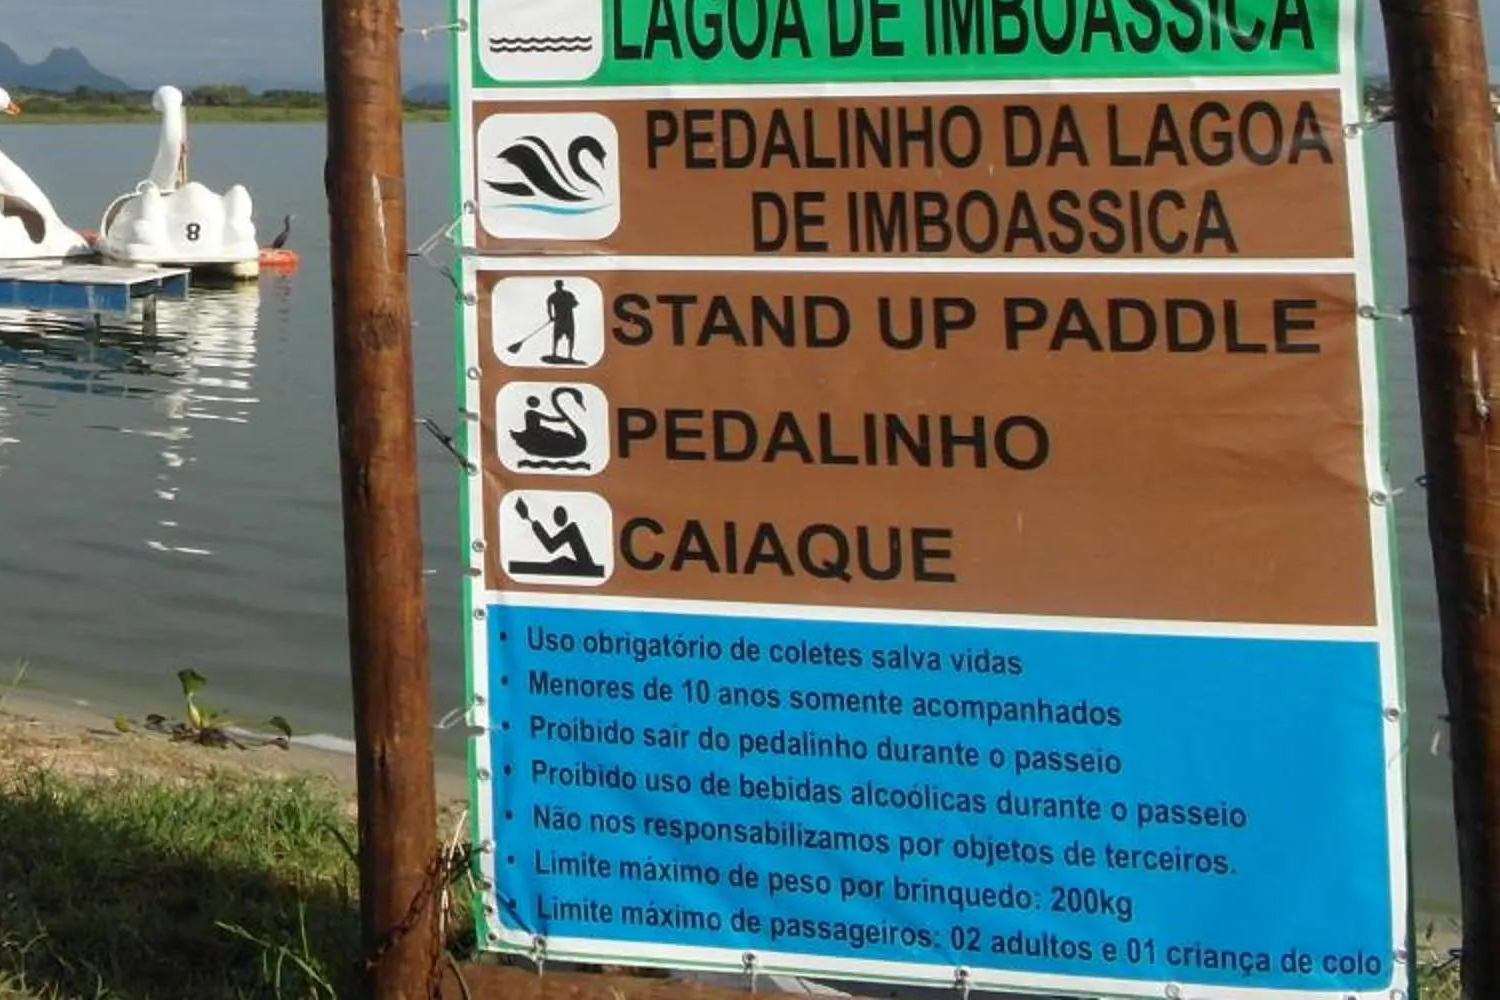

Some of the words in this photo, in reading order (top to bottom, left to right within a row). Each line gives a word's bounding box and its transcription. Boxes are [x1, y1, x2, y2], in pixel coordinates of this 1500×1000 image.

[646, 104, 982, 170] PEDALINHO
[1003, 104, 1089, 167] DA
[1107, 100, 1333, 167] LAGOA
[186, 222, 201, 242] 8
[752, 191, 829, 253] DE
[848, 189, 1237, 255] IMBOASSICA
[612, 293, 851, 348] STAND
[878, 297, 977, 350] UP
[1004, 297, 1320, 354] PADDLE
[617, 407, 1050, 471] PEDALINHO
[620, 517, 956, 583] CAIAQUE
[527, 625, 576, 653] Uso
[582, 630, 723, 663] obrigatório
[729, 636, 761, 662] de
[769, 640, 863, 668] coletes
[871, 644, 942, 671] salva
[950, 648, 1023, 675] vidas
[529, 668, 635, 700] Menores
[643, 676, 673, 702] de
[682, 678, 711, 705] 10
[718, 685, 781, 709] anos
[789, 689, 903, 715] somente
[912, 696, 1123, 727] acompanhados
[643, 726, 690, 749] sair
[698, 725, 731, 751] do
[739, 729, 868, 760] pedalinho
[877, 735, 979, 767] durante
[989, 747, 1005, 769] o
[1015, 748, 1122, 775] passeio
[645, 772, 692, 794] uso
[700, 770, 731, 797] de
[739, 772, 842, 805] bebidas
[851, 780, 987, 814] alcoólicas
[996, 790, 1101, 821] durante
[1111, 801, 1128, 822] o
[1137, 802, 1247, 829] passeio
[533, 804, 582, 831] Não
[590, 813, 636, 834] nos
[643, 815, 890, 854] responsabilizamos
[899, 835, 945, 861] por
[952, 833, 1054, 867] objetos
[1063, 840, 1096, 867] de
[1105, 842, 1236, 875] terceiros.
[535, 849, 612, 878] Limite
[619, 856, 721, 886] máximo
[727, 862, 759, 889] de
[767, 870, 831, 898] peso
[840, 876, 885, 902] por
[893, 874, 1040, 912] brinquedo:
[1051, 884, 1133, 923] 200kg
[536, 892, 613, 924] Limite
[621, 901, 722, 931] máximo
[730, 906, 763, 934] de
[769, 916, 941, 949] passageiros:
[950, 924, 982, 953] 02
[990, 929, 1093, 961] adultos
[1102, 941, 1117, 963] e
[1127, 937, 1155, 964] 01
[1166, 945, 1271, 977] criança
[1280, 948, 1313, 974] de
[1322, 950, 1382, 976] colo
